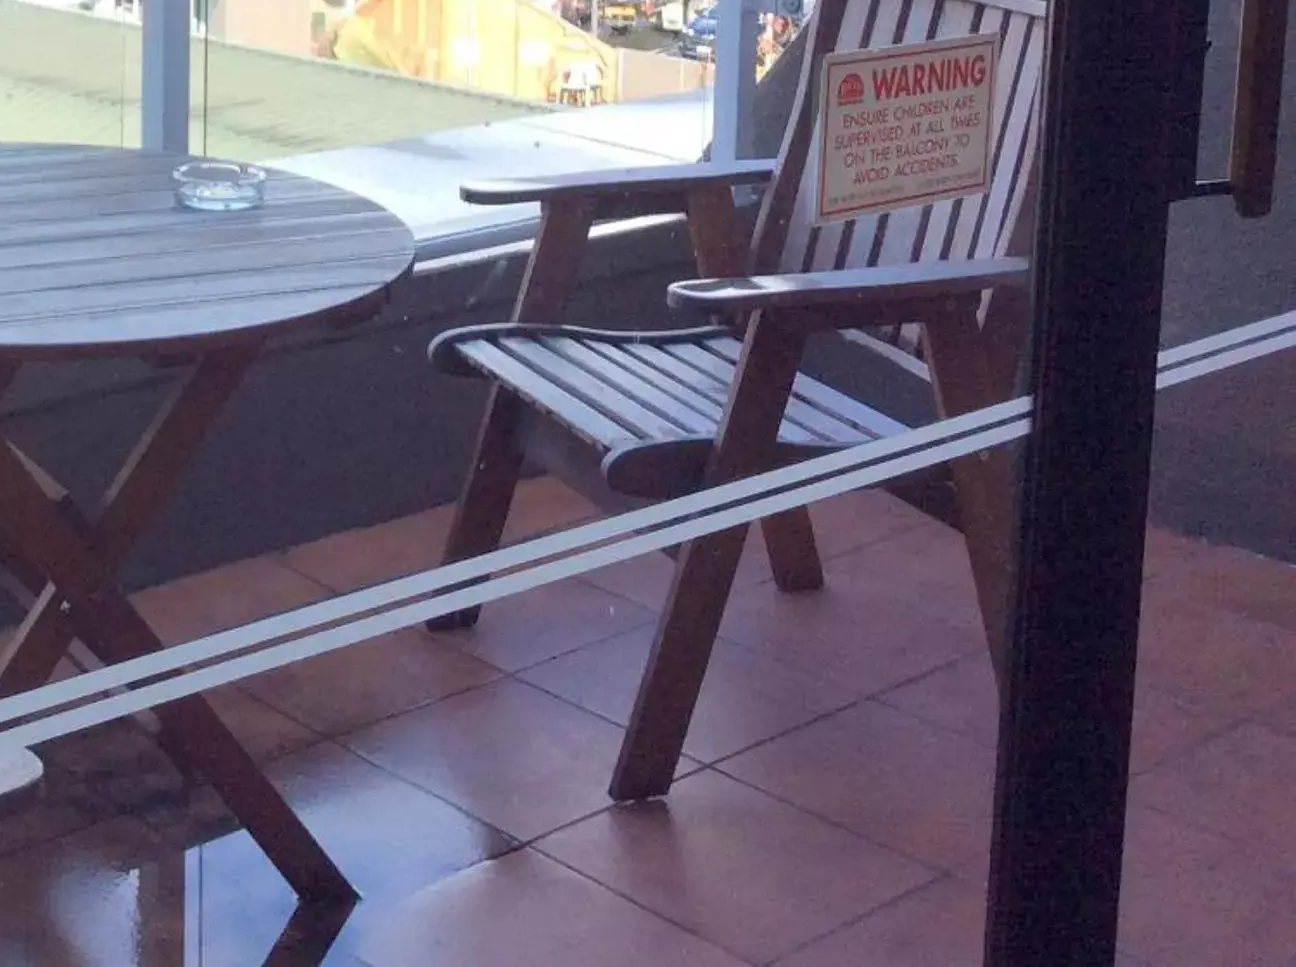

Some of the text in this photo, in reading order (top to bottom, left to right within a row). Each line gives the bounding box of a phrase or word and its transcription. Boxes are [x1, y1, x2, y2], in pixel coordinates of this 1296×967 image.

[872, 54, 986, 100] WARNING
[843, 95, 976, 129] ENSURE CHILDREN ARE
[834, 113, 980, 150] SUPERVISED AT ALL TIMES
[844, 134, 970, 168] ON THE BALCONY TO
[853, 168, 889, 185] AVOID
